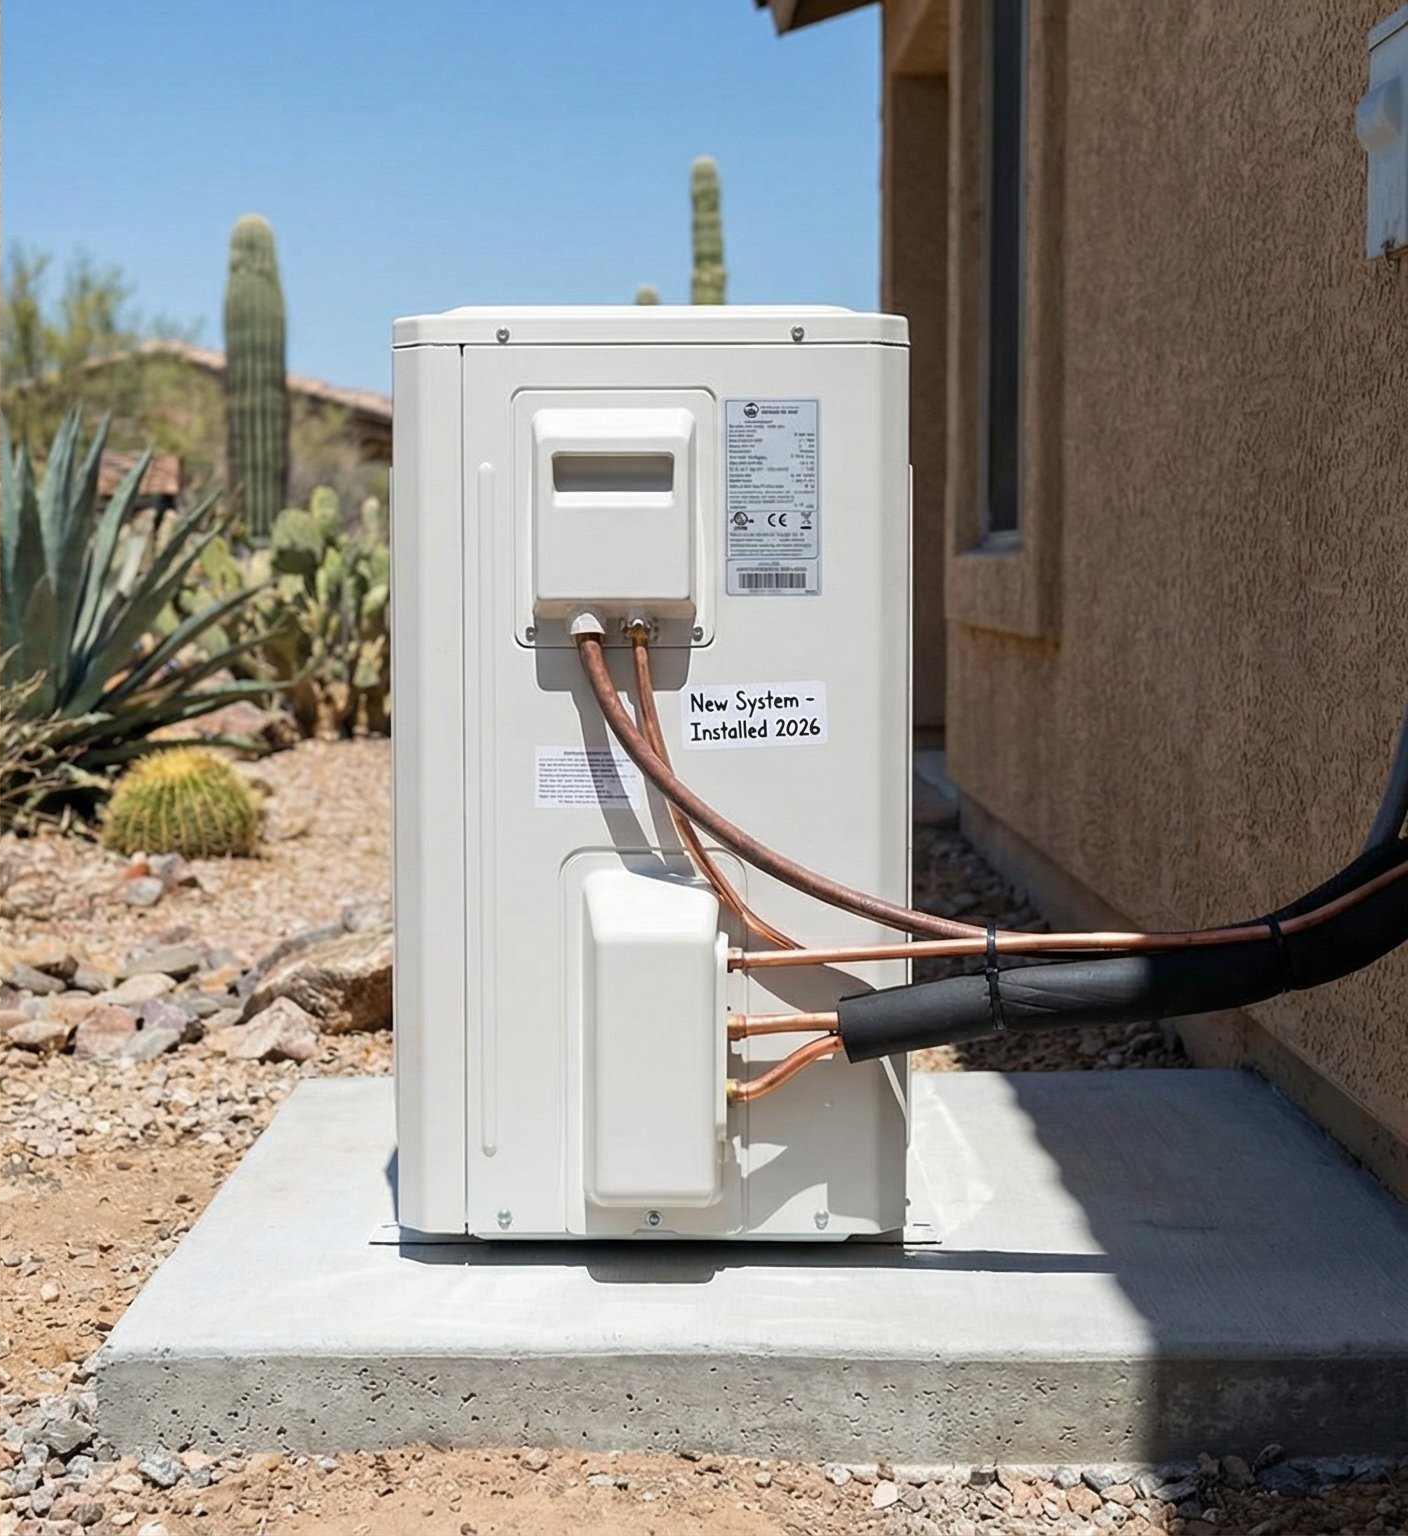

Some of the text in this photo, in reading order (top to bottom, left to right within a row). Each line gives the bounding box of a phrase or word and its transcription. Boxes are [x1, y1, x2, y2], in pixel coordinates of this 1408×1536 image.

[690, 693, 728, 713] New
[735, 690, 799, 718] System
[690, 717, 821, 741] Installed 2026
